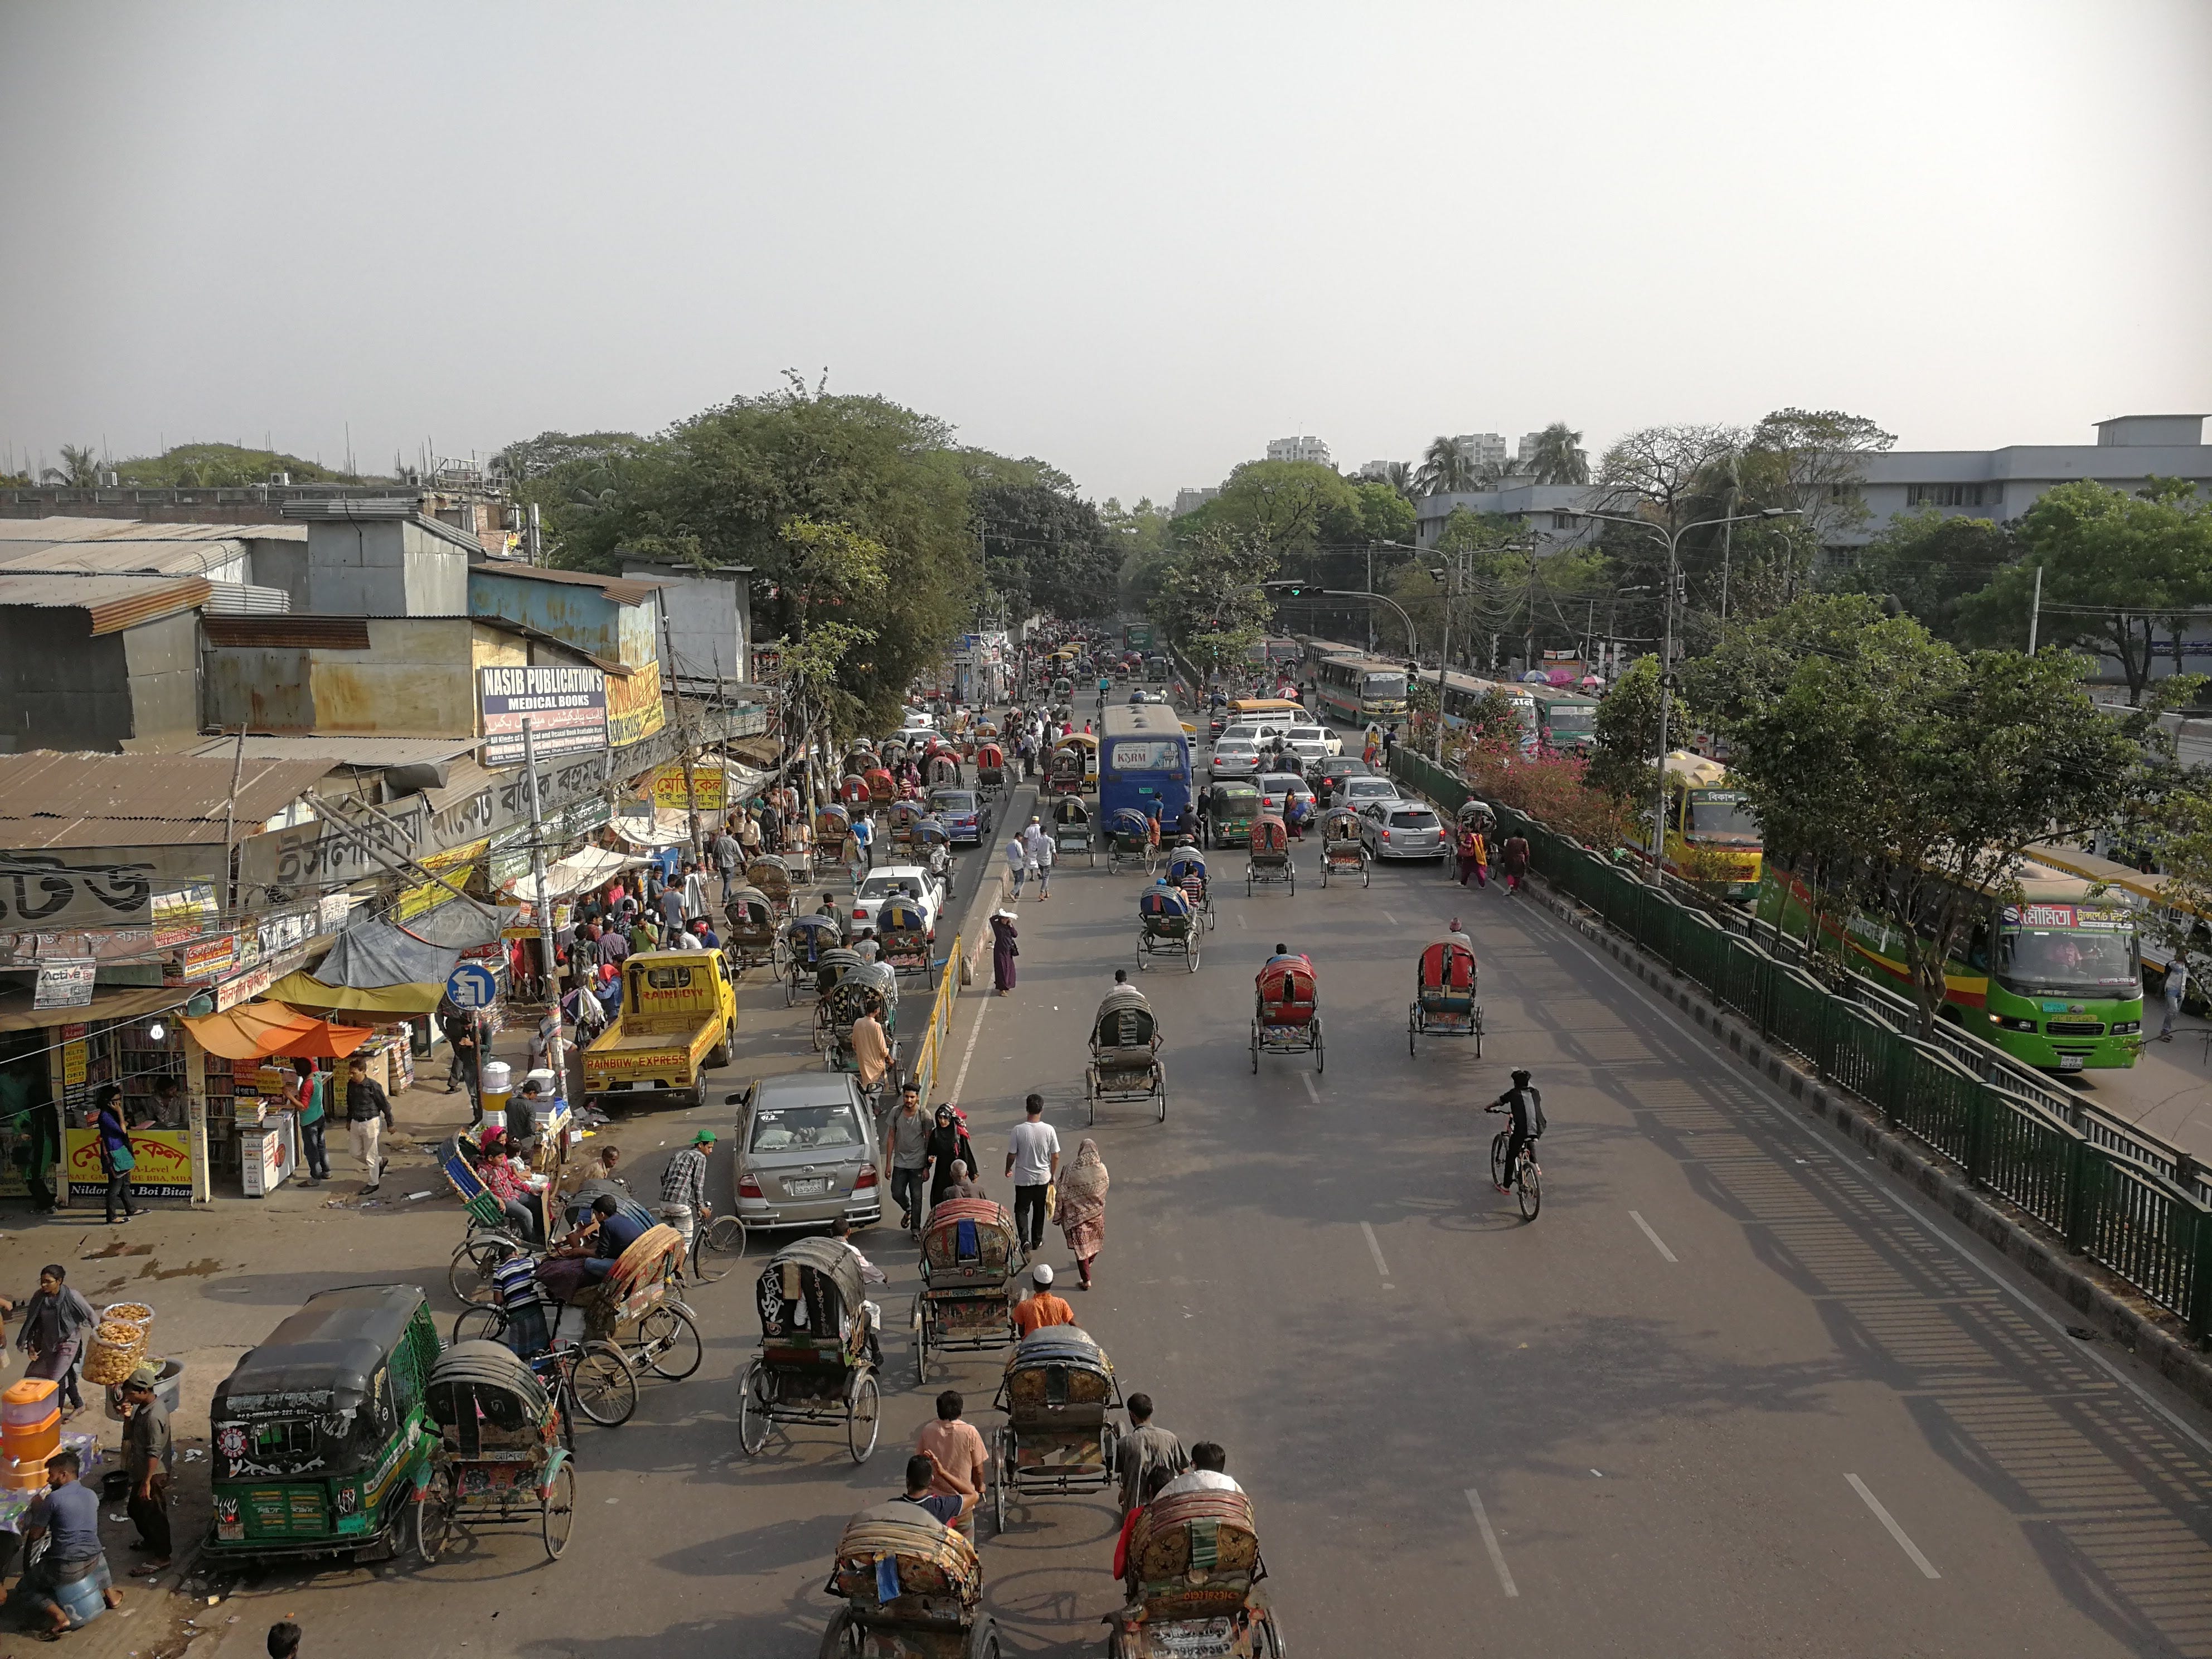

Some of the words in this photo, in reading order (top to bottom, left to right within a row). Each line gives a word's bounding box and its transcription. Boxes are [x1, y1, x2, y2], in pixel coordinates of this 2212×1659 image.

[484, 668, 525, 696] NASIB
[527, 668, 603, 695] PUBLICATION'S
[508, 696, 557, 710] MEDICAL
[559, 695, 589, 706] BOOKS
[499, 735, 514, 743] Kinds
[503, 744, 516, 753] One
[1118, 753, 1146, 764] KSRM
[1708, 792, 1735, 802] বিকাশ
[2023, 905, 2071, 926] মৌমিতা
[213, 949, 231, 957] China
[41, 966, 81, 981] Active
[643, 987, 704, 1000] RAINBOW
[587, 1058, 632, 1070] RAINBOW
[639, 1055, 685, 1067] EXPRESS
[134, 1165, 169, 1173] A-Level
[136, 1187, 159, 1196] Boi
[161, 1187, 193, 1196] Bitan
